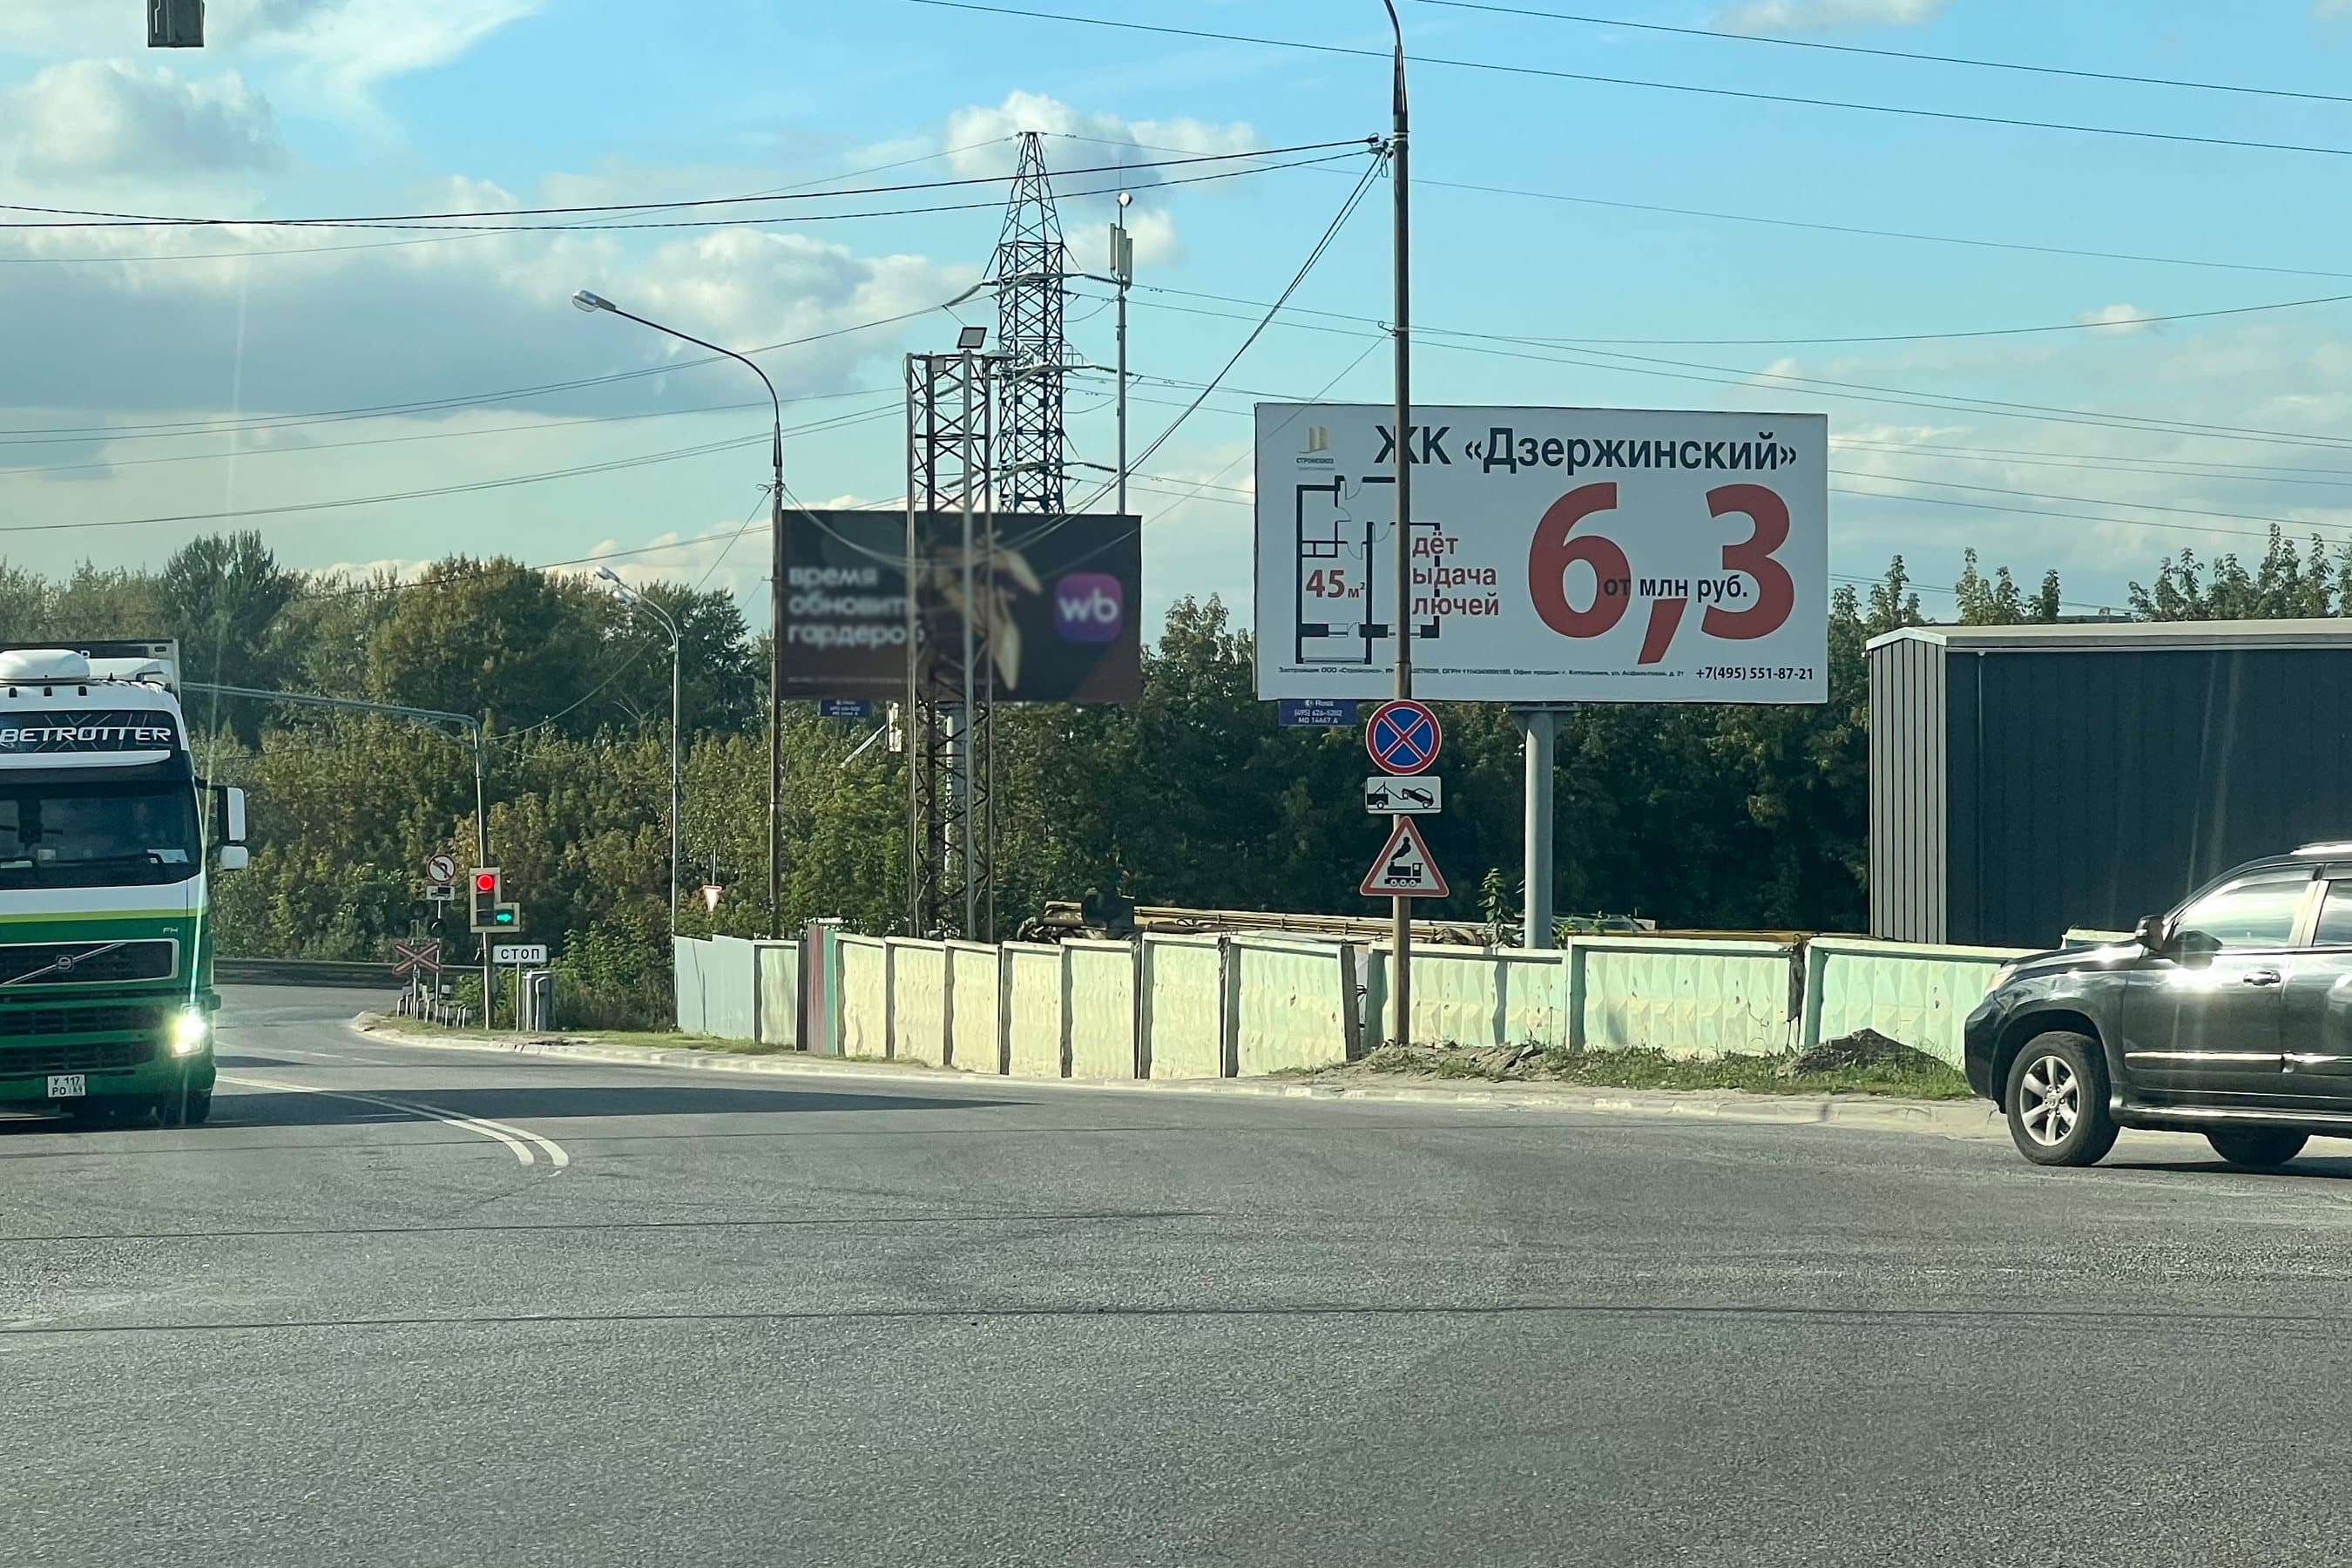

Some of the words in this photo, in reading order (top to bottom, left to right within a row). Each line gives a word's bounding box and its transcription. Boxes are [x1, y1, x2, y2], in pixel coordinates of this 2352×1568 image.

[1374, 425, 1452, 464] ЖК
[1465, 428, 1797, 476] «Дзержинский»
[1412, 531, 1459, 558] дёт
[788, 567, 879, 592] время
[1412, 567, 1497, 589] ыдача
[1528, 482, 1795, 665] 6,3
[1639, 578, 1688, 597] млн
[1697, 574, 1748, 603] руб.
[788, 590, 920, 617] обновит
[1058, 586, 1119, 624] wb
[1412, 592, 1499, 616] лючей
[1696, 666, 1747, 680] +7(495)
[1749, 667, 1814, 680] 551-87-21
[0, 727, 172, 742] BETROTTER
[501, 949, 540, 959] СТОП
